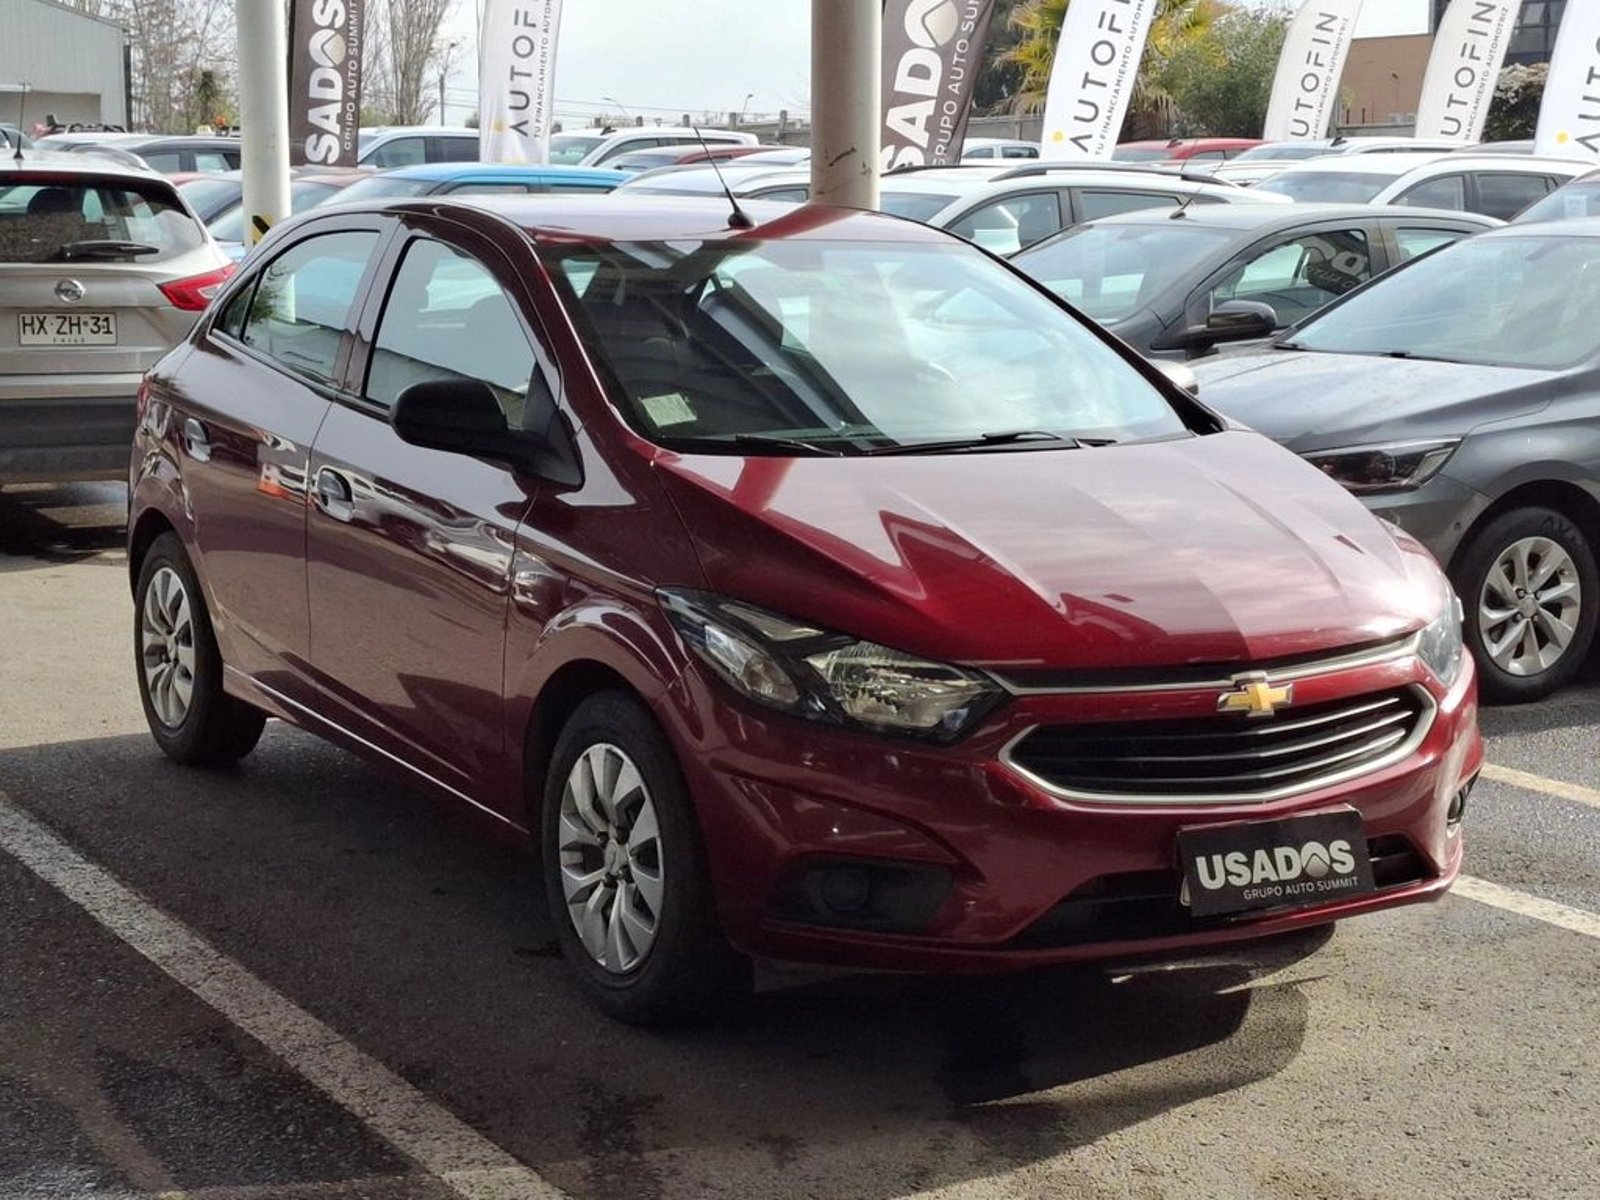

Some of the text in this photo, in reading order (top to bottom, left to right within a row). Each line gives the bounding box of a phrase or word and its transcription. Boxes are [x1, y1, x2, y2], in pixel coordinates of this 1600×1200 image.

[1486, 6, 1509, 66] AUTOMOTRIZ
[346, 60, 358, 99] AUTO
[508, 0, 538, 138] AUTOF
[535, 37, 549, 124] FINANCIAMIENTO
[948, 38, 970, 95] AUTO
[1095, 0, 1145, 155] TU FINANCIAMIENTO AUTOM
[1575, 36, 1600, 153] AUT
[533, 126, 542, 139] TU
[1196, 840, 1355, 890] USADOS
[1243, 876, 1359, 900] GRUPO AUTO SUMMIT
